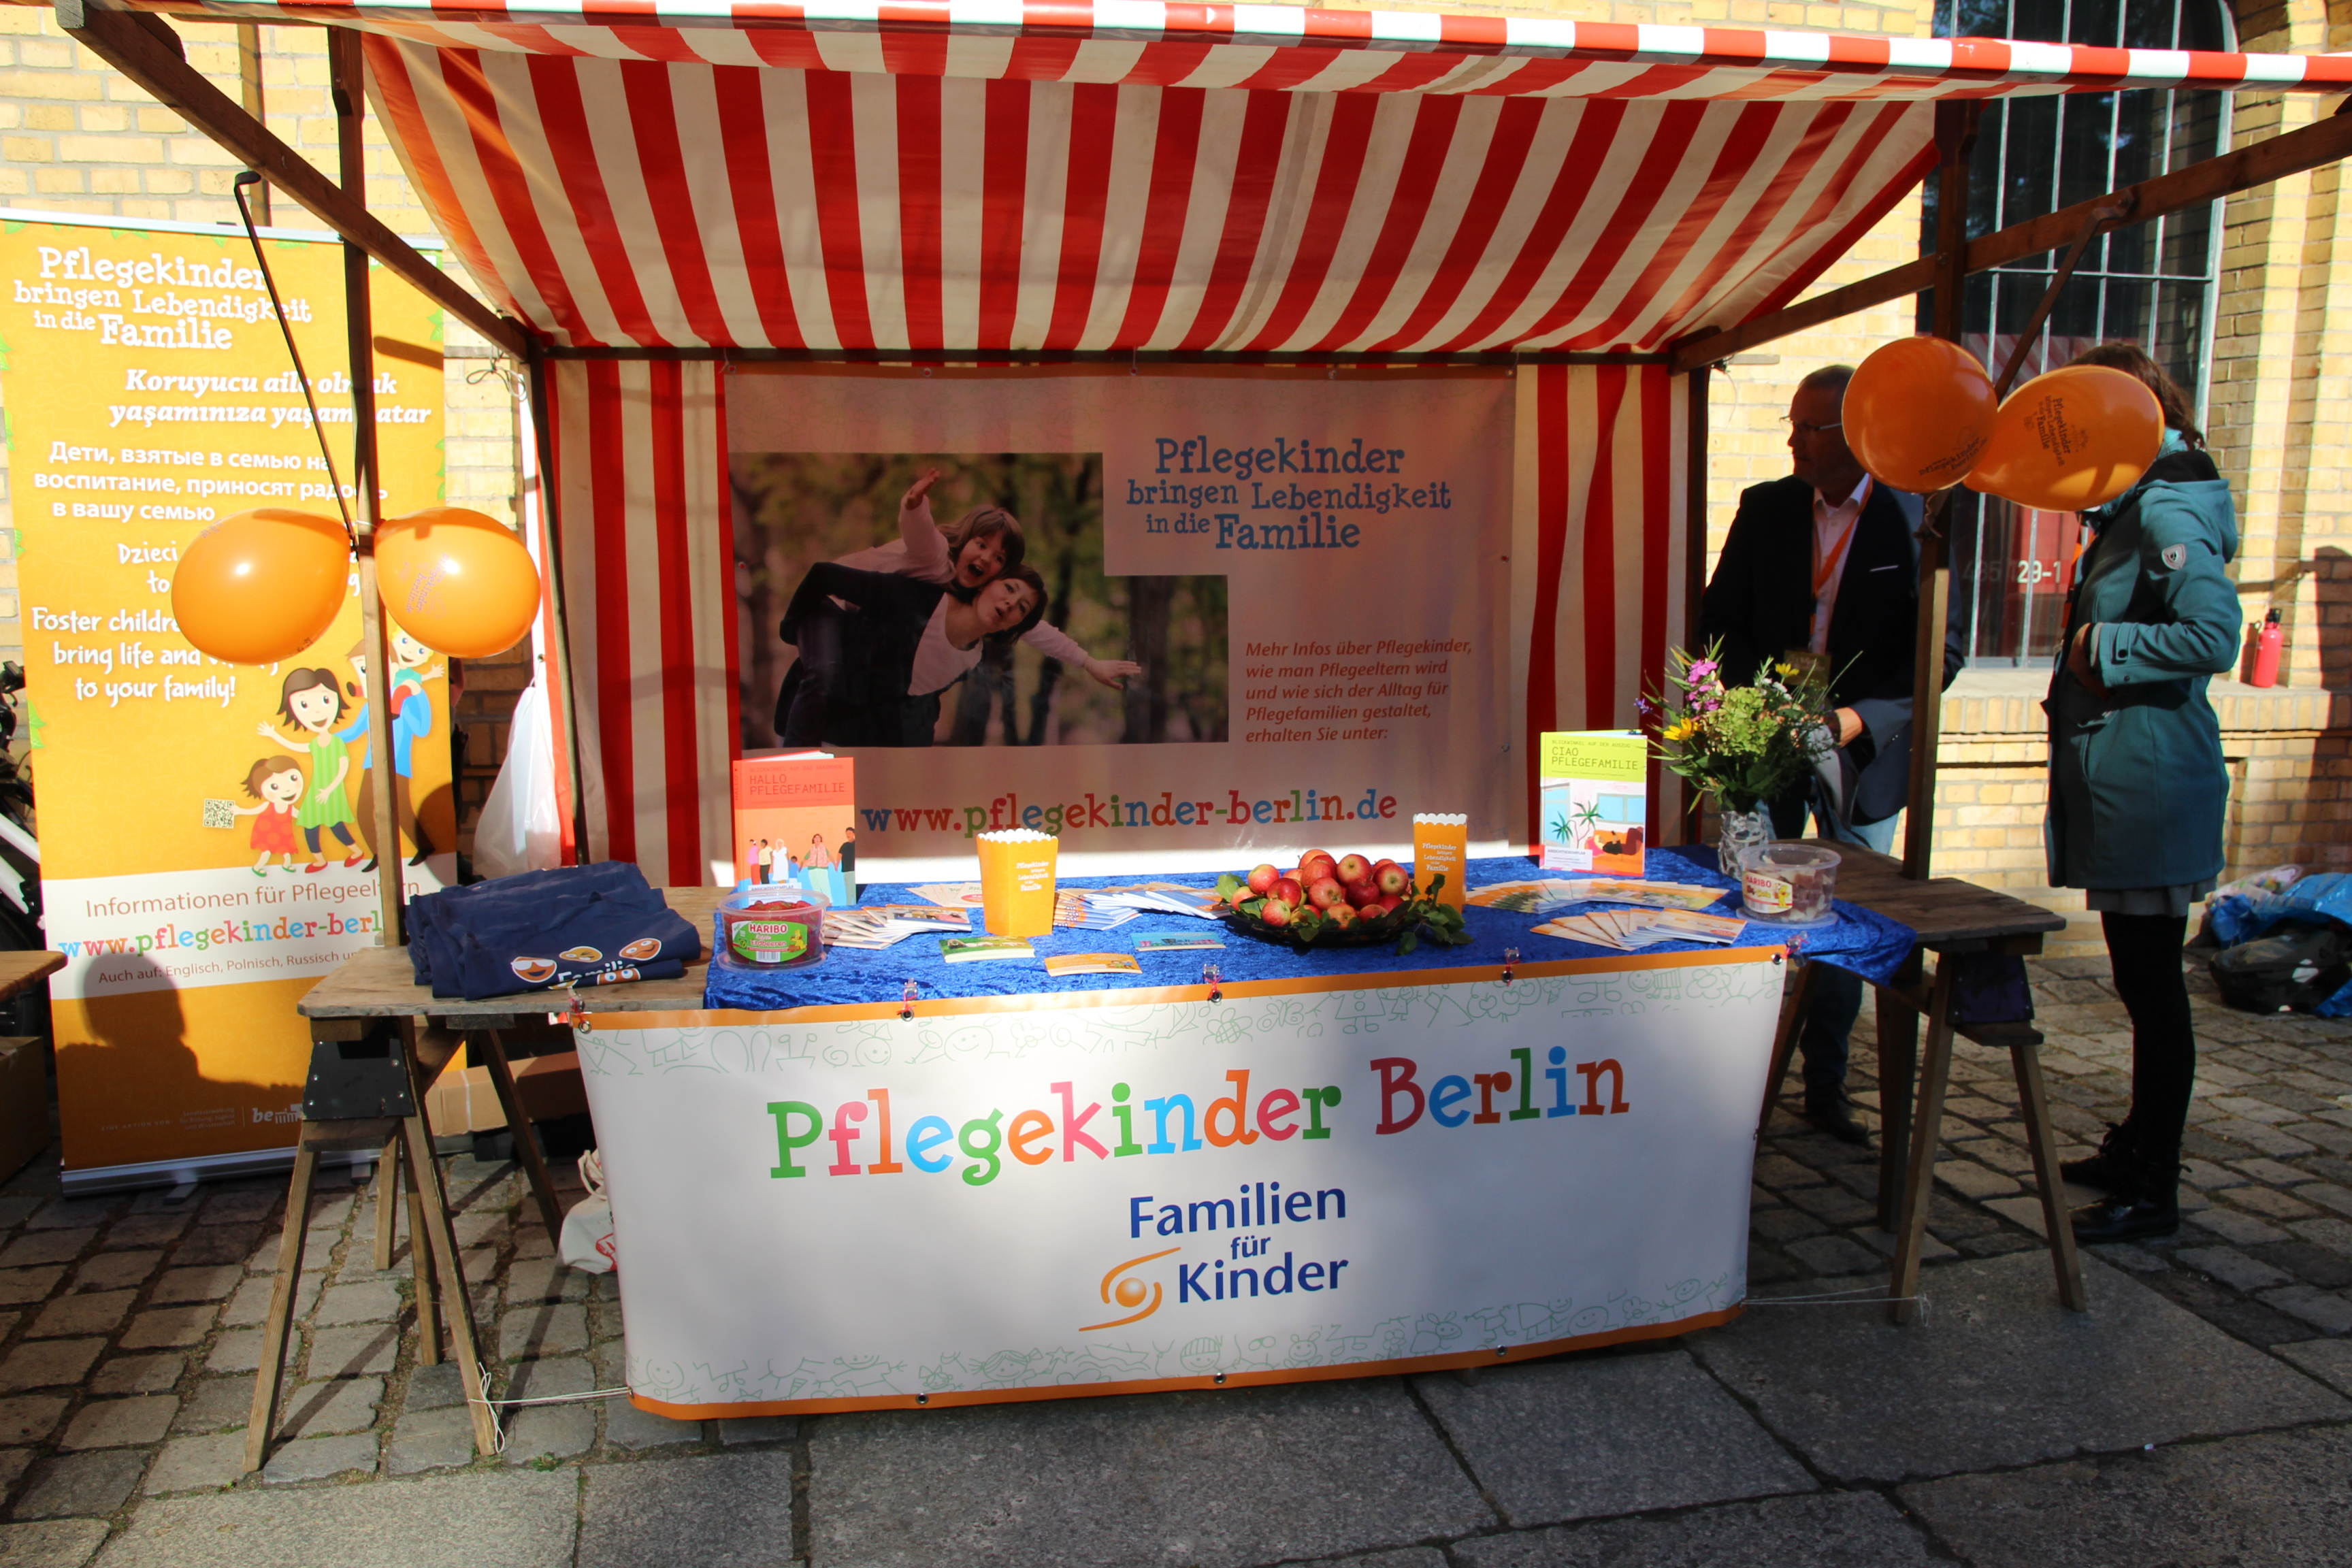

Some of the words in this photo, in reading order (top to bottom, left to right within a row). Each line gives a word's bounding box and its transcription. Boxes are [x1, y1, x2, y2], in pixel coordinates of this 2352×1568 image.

[38, 246, 266, 291] Pflegekinder
[14, 280, 121, 310] bringen
[33, 310, 57, 328] in
[61, 310, 96, 331] die
[98, 316, 233, 350] Familie
[125, 368, 259, 399] Koruyucu
[108, 405, 267, 428] yaşamınıza
[375, 404, 431, 423] atar
[2053, 397, 2072, 454] Pflegekinder
[49, 441, 115, 465] Дети,
[121, 448, 204, 466] взятые
[210, 452, 223, 466] в
[228, 453, 301, 470] семью
[1155, 435, 1405, 480] Pflegekinder
[34, 473, 181, 495] воспитание,
[186, 478, 295, 498] приносят
[1126, 479, 1239, 508] bringen
[1251, 481, 1452, 514] Lebendigkeit
[52, 502, 67, 517] в
[72, 503, 134, 523] вашу
[140, 504, 215, 521] семью
[1146, 512, 1170, 534] in
[1174, 512, 1211, 534] die
[1214, 511, 1361, 550] Familie
[117, 540, 178, 564] Dzieci
[146, 570, 170, 593] to
[31, 606, 102, 634] Foster
[108, 608, 181, 633] childre
[53, 641, 113, 675] bring
[119, 641, 154, 669] life
[160, 646, 201, 666] and
[1245, 642, 1288, 657] Mehr
[1293, 641, 1332, 656] Infos
[1336, 641, 1372, 655] über
[1376, 638, 1473, 658] Pflegekinder,
[1245, 664, 1273, 678] wie
[1278, 665, 1313, 678] man
[1319, 662, 1410, 681] Pflegeeltern
[1415, 660, 1448, 674] wird
[76, 677, 98, 701] to
[105, 682, 158, 708] your
[163, 674, 236, 708] family!
[1245, 685, 1277, 700] und
[1282, 685, 1309, 699] wie
[1313, 683, 1343, 698] sich
[1348, 683, 1374, 698] der
[1377, 682, 1422, 700] Alltag
[1425, 681, 1449, 696] für
[1245, 705, 1358, 724] Pflegefamilien
[1361, 703, 1431, 722] gestaltet,
[1245, 728, 1311, 742] erhalten
[1316, 727, 1338, 740] Sie
[1342, 728, 1388, 740] unter:
[1552, 747, 1579, 757] CIAO
[1552, 756, 1639, 770] PFLEGEFAMILIE
[749, 774, 787, 785] HALLO
[750, 783, 845, 796] PFLEGEFAMILIE
[860, 789, 1397, 838] www.pflegekinder-berlin.de
[1422, 843, 1457, 851] Pflegekinder
[1016, 860, 1050, 869] Pflegekinder
[1017, 872, 1049, 881] Lebendigkeit
[1426, 864, 1450, 872] Familie
[1020, 883, 1042, 892] Familie
[1746, 875, 1771, 887] HARIBO
[86, 892, 250, 917] Informationen
[255, 886, 286, 904] für
[58, 910, 383, 958] www.pflegekinder-berl
[749, 924, 788, 934] HARIBO
[99, 969, 133, 983] Auch
[137, 966, 163, 980] auf:
[166, 961, 224, 978] Englisch,
[227, 956, 284, 970] Polnisch,
[287, 951, 339, 966] Russisch
[252, 1108, 274, 1124] be
[766, 1068, 1342, 1186] Pflegekinder
[1369, 1045, 1630, 1135] Berlin
[1130, 1181, 1347, 1239] Familien
[1230, 1232, 1271, 1260] für
[1178, 1251, 1350, 1304] Kinder
